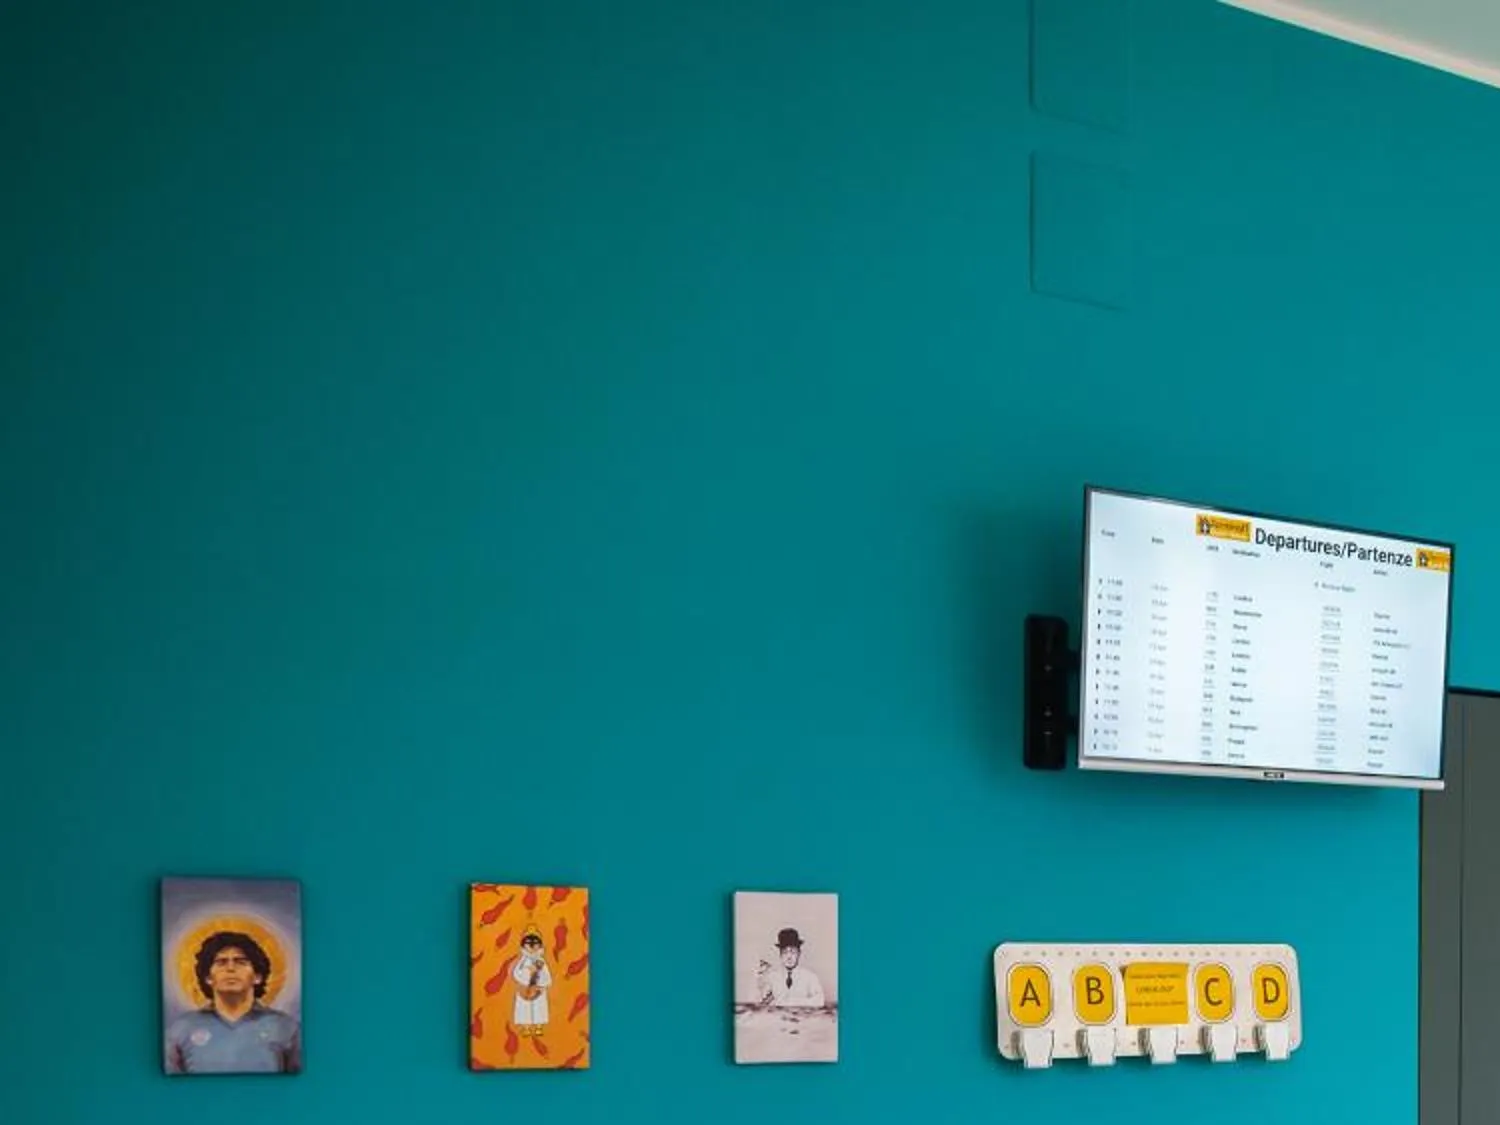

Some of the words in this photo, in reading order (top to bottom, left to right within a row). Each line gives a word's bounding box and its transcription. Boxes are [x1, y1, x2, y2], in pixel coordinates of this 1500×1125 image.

[1255, 527, 1413, 567] Departures/Partenze
[1019, 978, 1042, 1008] A
[1085, 976, 1105, 1006] B
[1204, 977, 1223, 1006] C
[1262, 976, 1281, 1005] D
